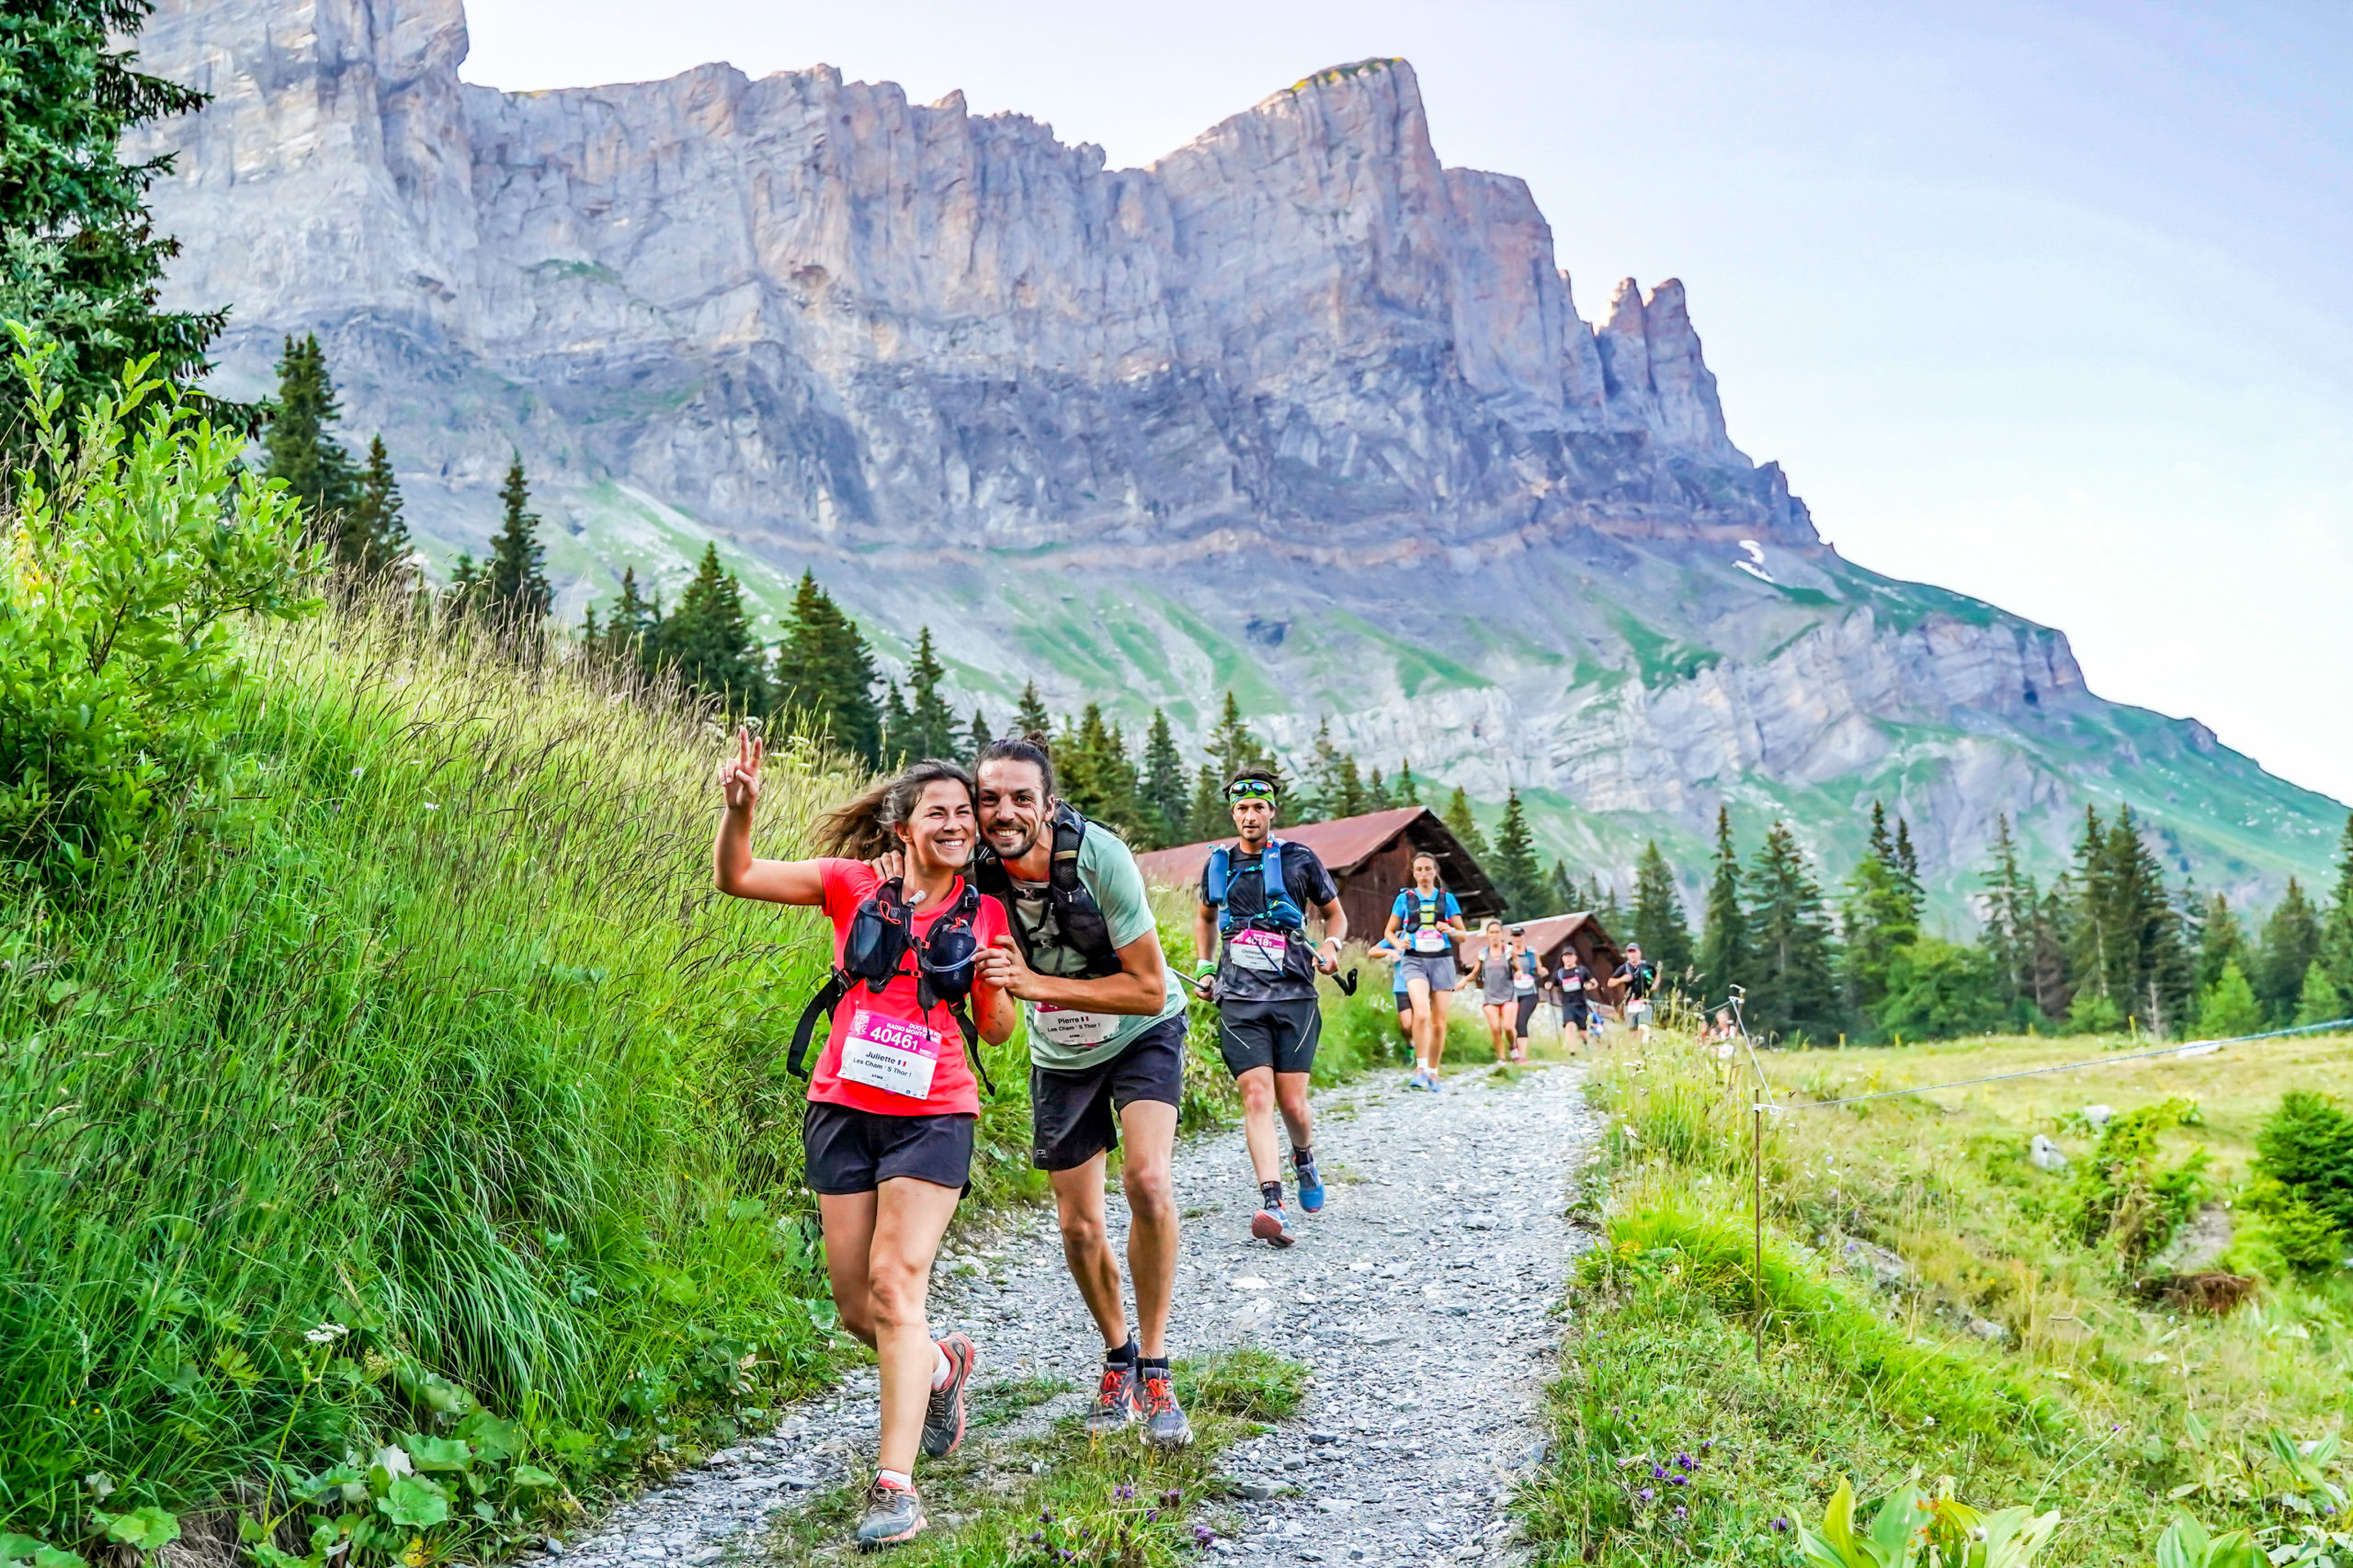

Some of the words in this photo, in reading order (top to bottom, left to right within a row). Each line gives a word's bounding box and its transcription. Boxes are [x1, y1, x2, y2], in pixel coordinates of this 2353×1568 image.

[886, 1022, 905, 1032] RADIO
[909, 1023, 922, 1031] DUO
[870, 1026, 918, 1051] 40461
[866, 1051, 896, 1064] Juliette
[853, 1057, 864, 1065] Les
[865, 1060, 883, 1070] Cham
[893, 1067, 908, 1077] Thor
